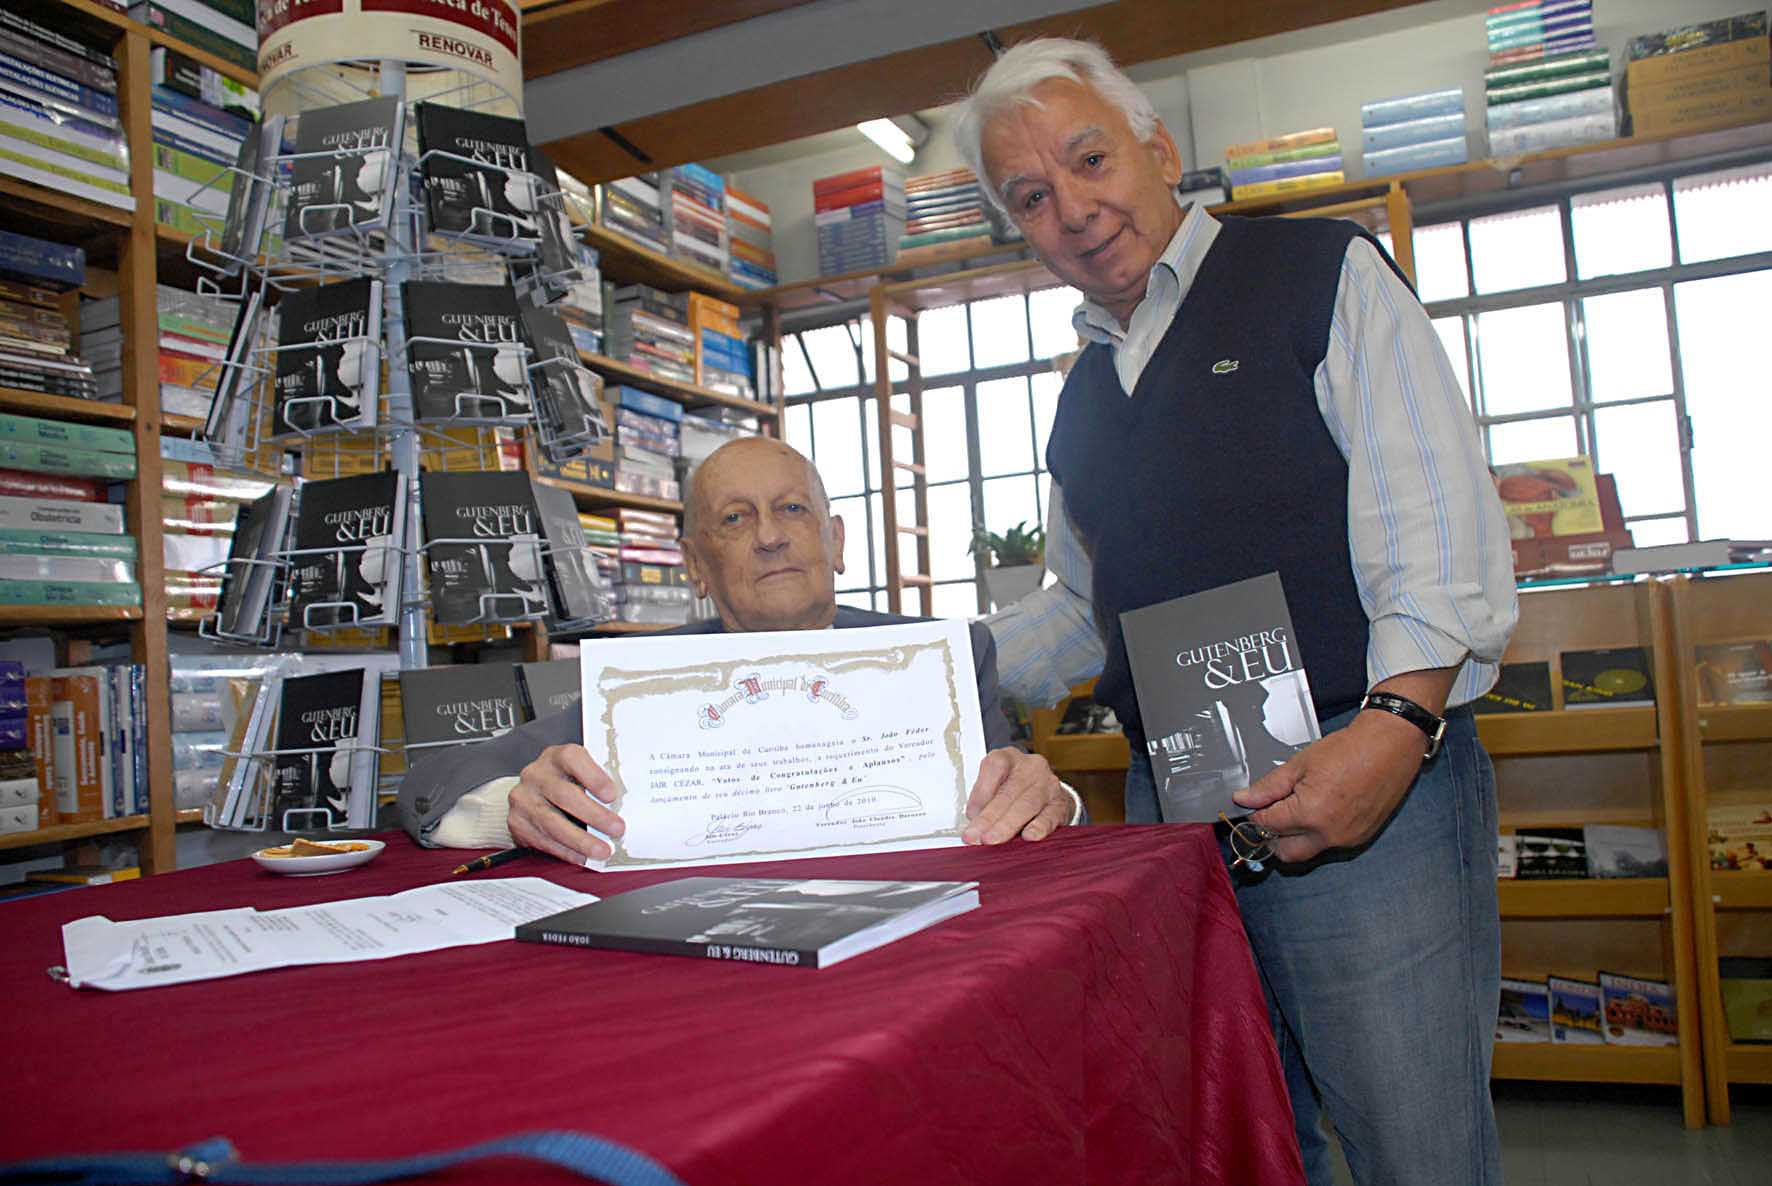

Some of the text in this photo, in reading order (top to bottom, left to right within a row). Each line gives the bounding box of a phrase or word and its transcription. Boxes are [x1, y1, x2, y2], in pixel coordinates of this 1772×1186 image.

[471, 2, 490, 20] de
[418, 33, 494, 67] RENOVAR
[322, 127, 389, 145] GUTENBERG
[455, 136, 521, 155] GUTENBERG
[303, 309, 365, 332] GUTENBERG
[441, 312, 516, 327] GUTENBERG
[482, 320, 517, 342] EU
[324, 504, 390, 524] GUTENBERG
[456, 504, 530, 518] GUTENBERG
[359, 512, 390, 538] EU
[498, 511, 532, 536] EU
[1176, 627, 1288, 667] GUTENBERG
[1204, 640, 1294, 689] & EU
[733, 672, 798, 705] Municipal
[300, 704, 358, 723] GUTENBERG
[436, 698, 512, 715] GUTENBERG
[480, 702, 516, 731] EU
[329, 712, 357, 740] EU
[660, 751, 690, 760] Câmara
[698, 748, 736, 758] Municipal
[758, 744, 789, 754] Curitiba
[898, 739, 934, 749] Vereador
[770, 767, 838, 778] Congratulações
[702, 791, 711, 799] de
[707, 945, 801, 965] GUTENBERG & EU
